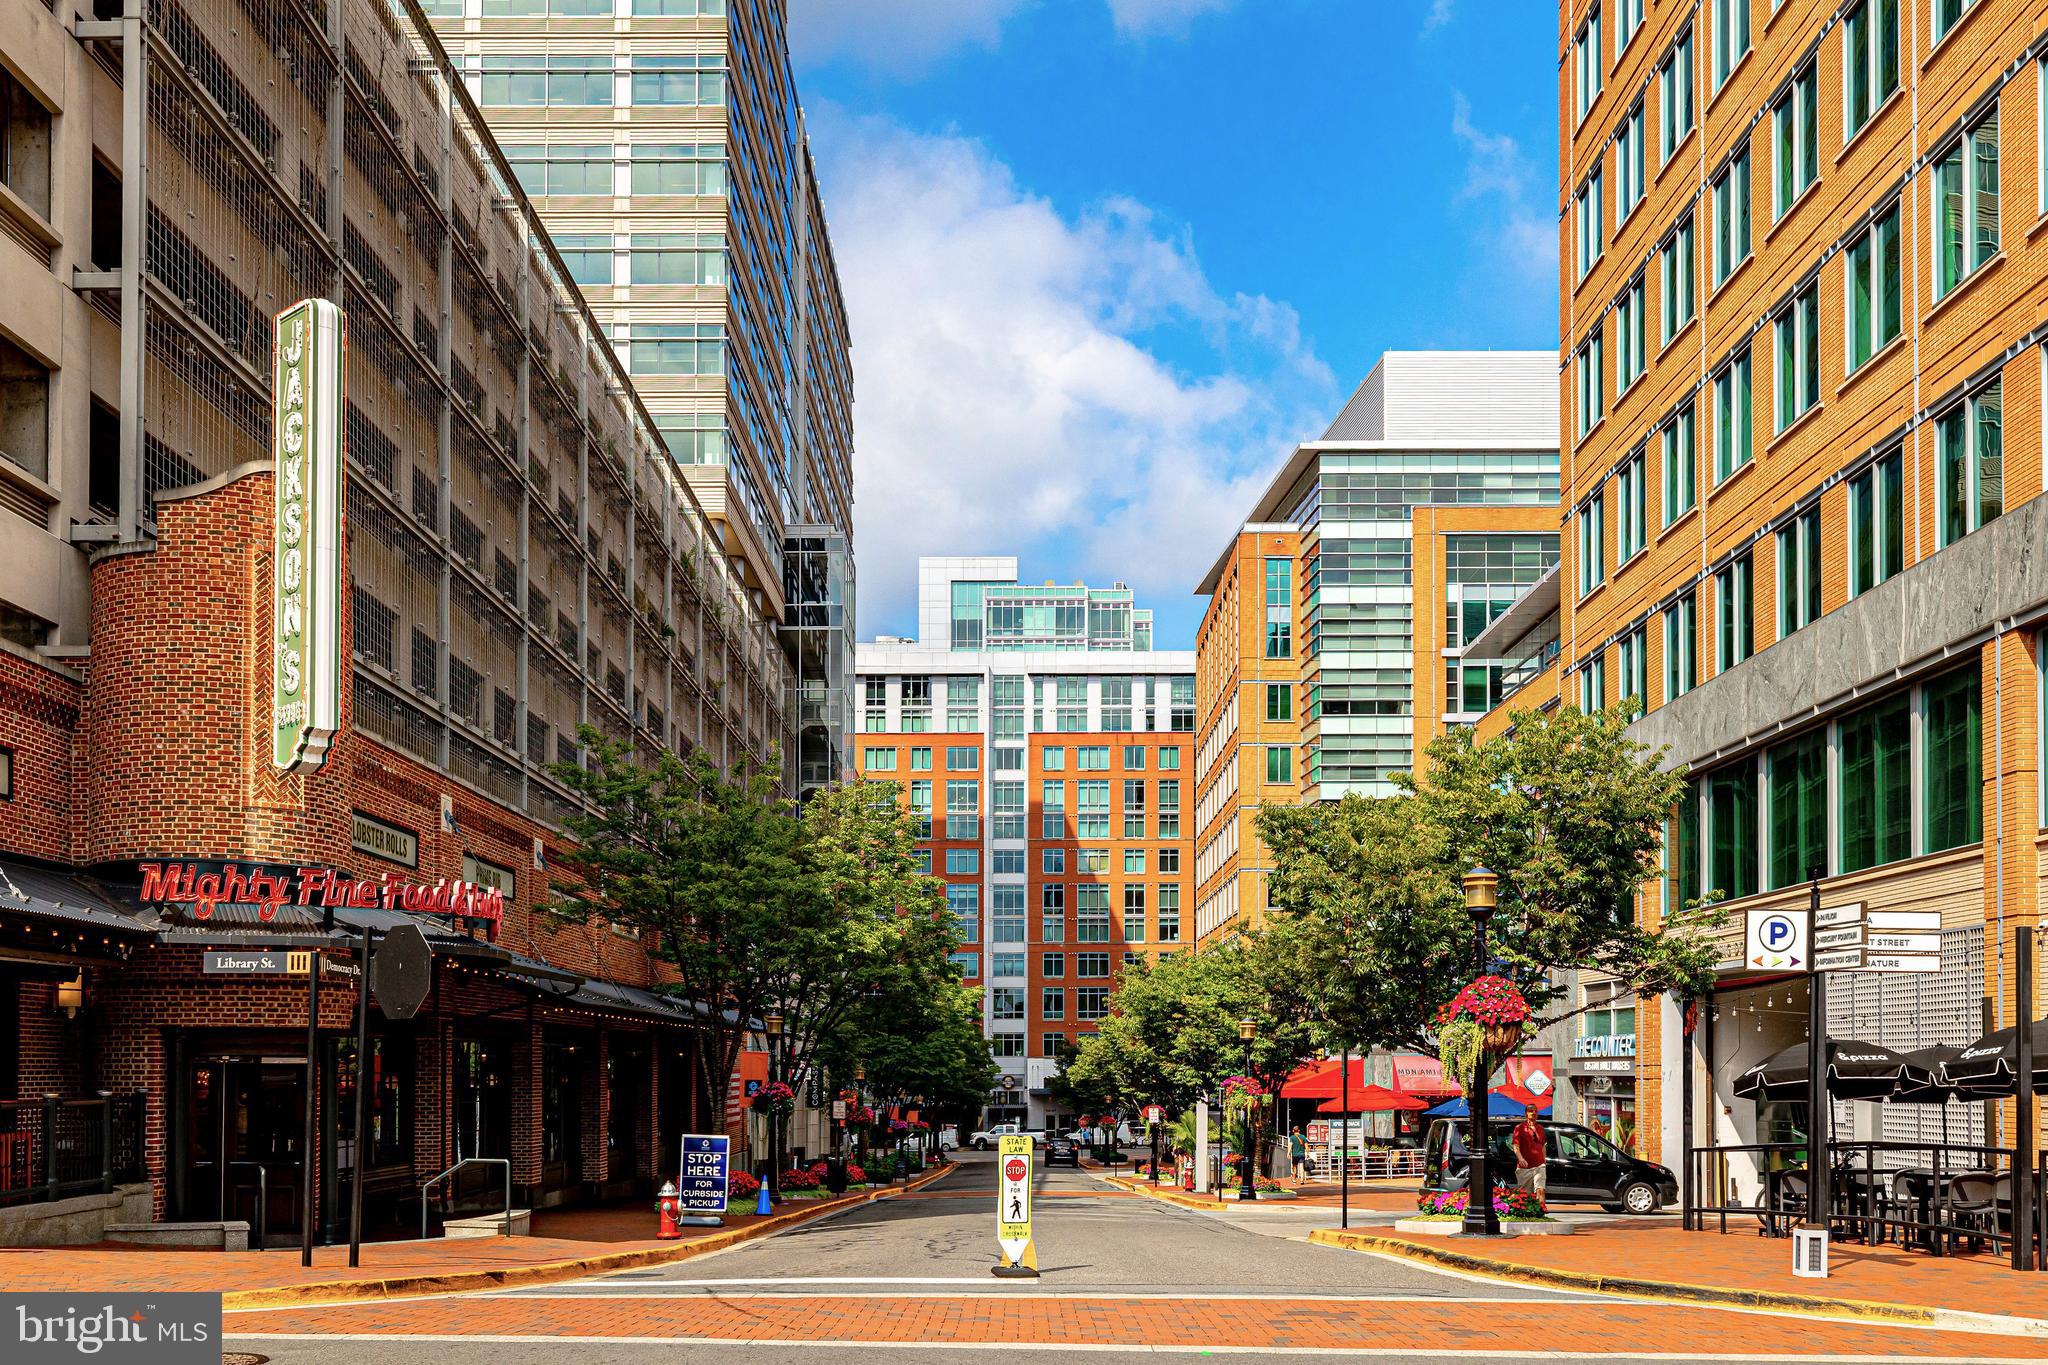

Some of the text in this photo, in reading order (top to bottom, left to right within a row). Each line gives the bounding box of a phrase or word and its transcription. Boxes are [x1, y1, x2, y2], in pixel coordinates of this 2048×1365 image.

[352, 819, 408, 858] LOBSTER ROLLS
[139, 863, 290, 922] Mighty
[297, 868, 379, 907] Fine
[381, 872, 450, 913] Food
[1770, 921, 1788, 945] P
[216, 957, 276, 971] Library St.
[1845, 954, 1860, 963] CENTER
[326, 959, 362, 977] Democracy Dr.
[1574, 1035, 1633, 1057] THE COUNTER
[1960, 1045, 2004, 1059] &pizza
[1837, 1052, 1888, 1062] &pizza
[688, 1153, 722, 1164] STOP
[687, 1166, 721, 1176] HERE
[1007, 1166, 1025, 1175] STOP
[695, 1180, 713, 1188] FOR
[683, 1189, 725, 1198] CURBSIDE
